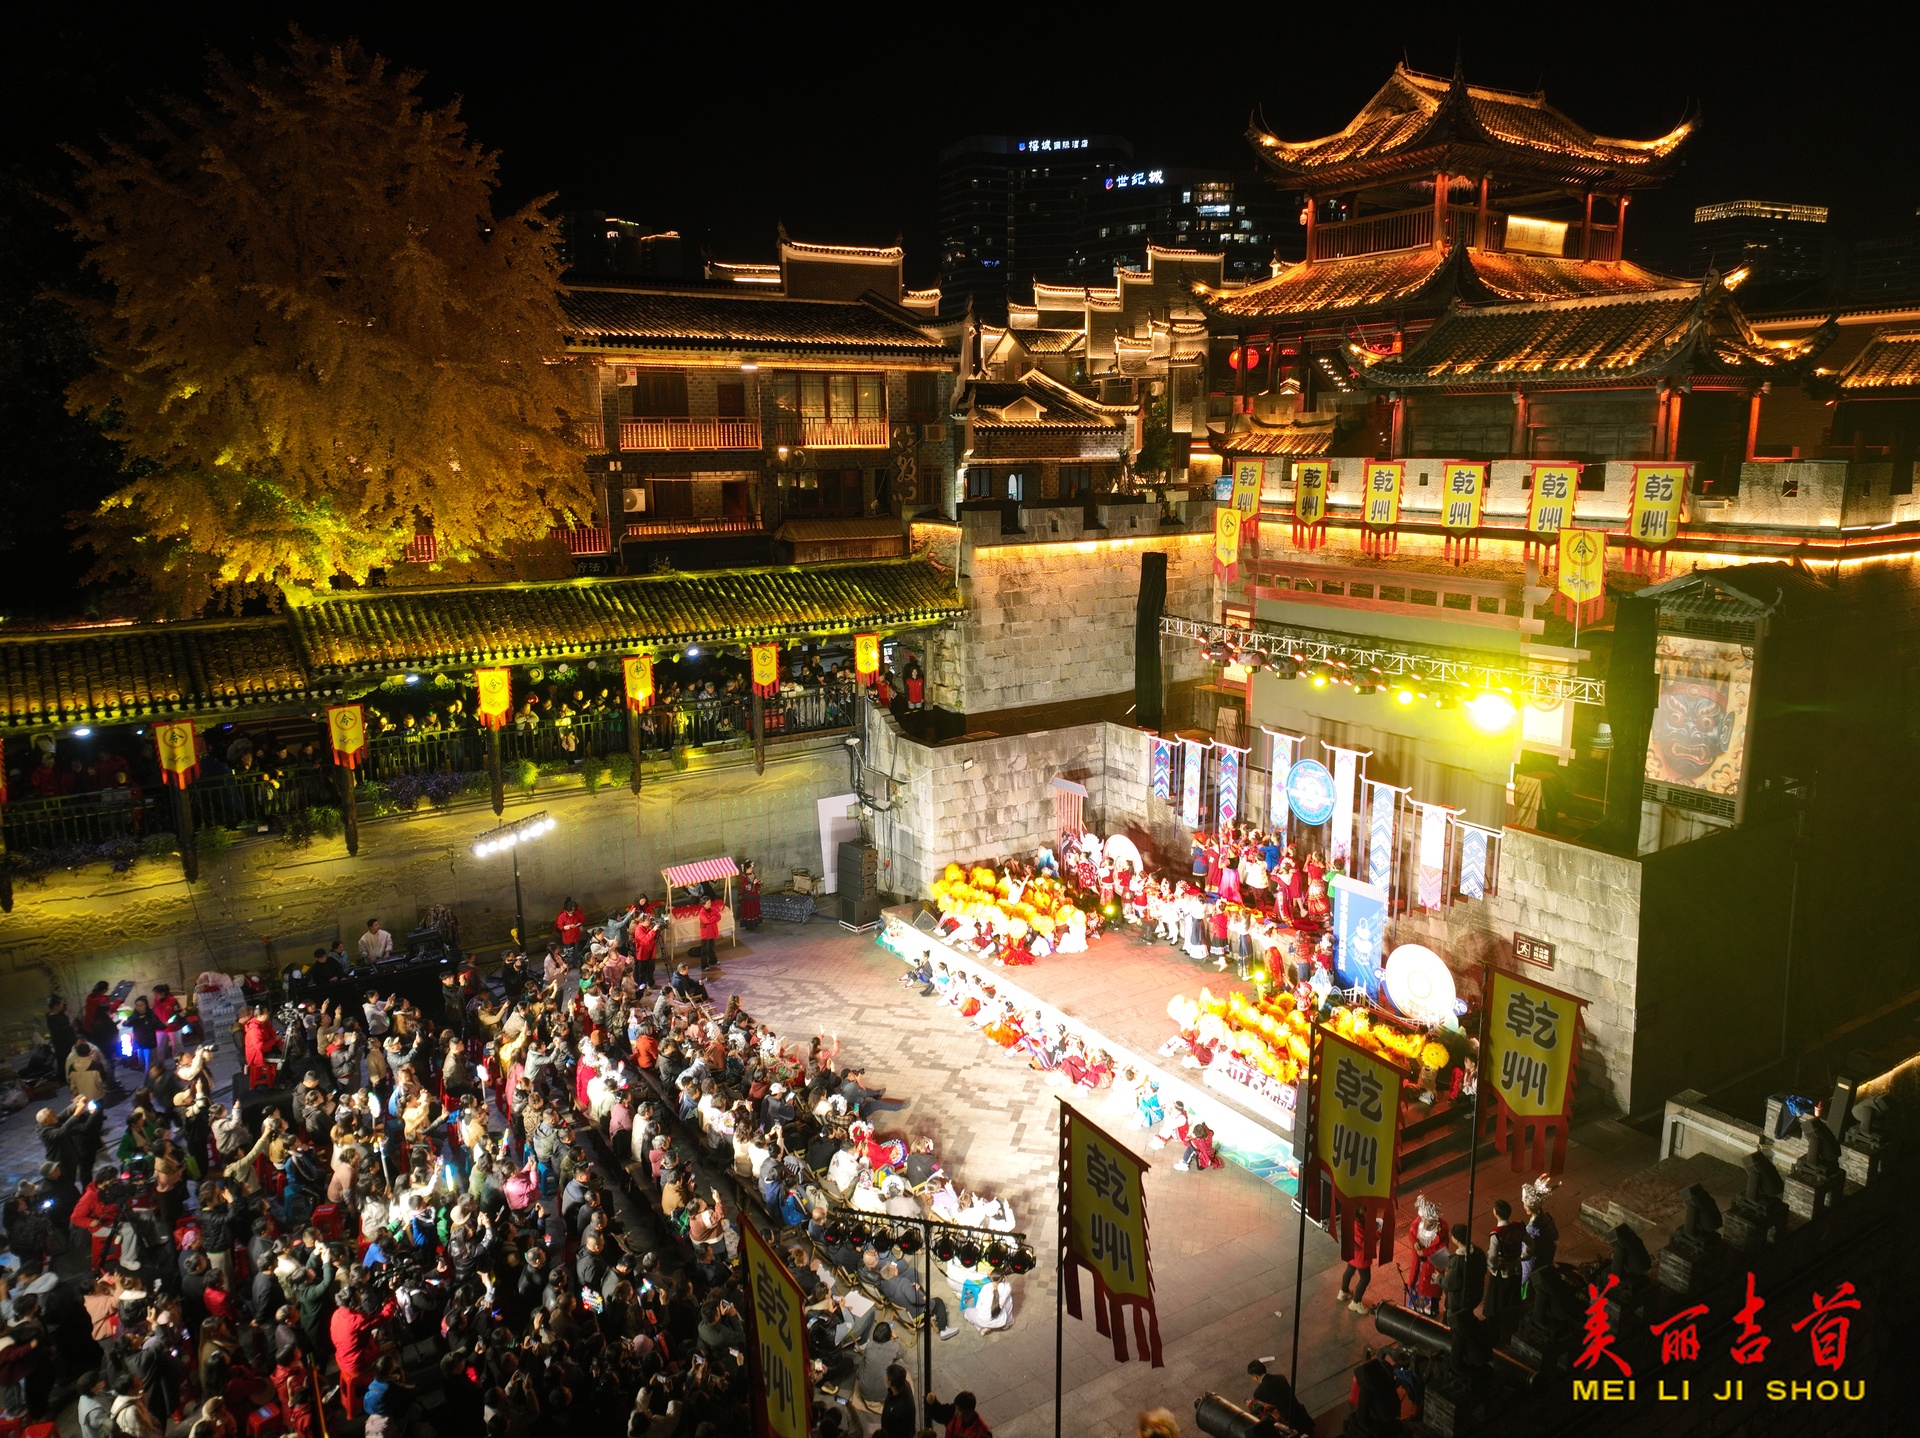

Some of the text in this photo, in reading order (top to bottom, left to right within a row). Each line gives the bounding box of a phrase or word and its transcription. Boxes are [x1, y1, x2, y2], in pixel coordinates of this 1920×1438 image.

[1115, 169, 1165, 189] 世纪城
[1237, 465, 1257, 514] 乾州
[1301, 466, 1323, 518] 乾州
[1370, 469, 1395, 523] 乾州
[1448, 469, 1476, 527] 乾州
[1537, 472, 1569, 533] 乾州
[1639, 473, 1676, 538] 乾州
[1223, 516, 1235, 531] 令
[1572, 538, 1594, 559] 令
[760, 652, 771, 663] 令
[168, 730, 185, 744] 令
[339, 714, 354, 727] 令
[1500, 990, 1560, 1107] 乾州
[1332, 1056, 1385, 1187] 乾州
[1085, 1141, 1135, 1284] 乾州
[756, 1259, 798, 1431] 乾州
